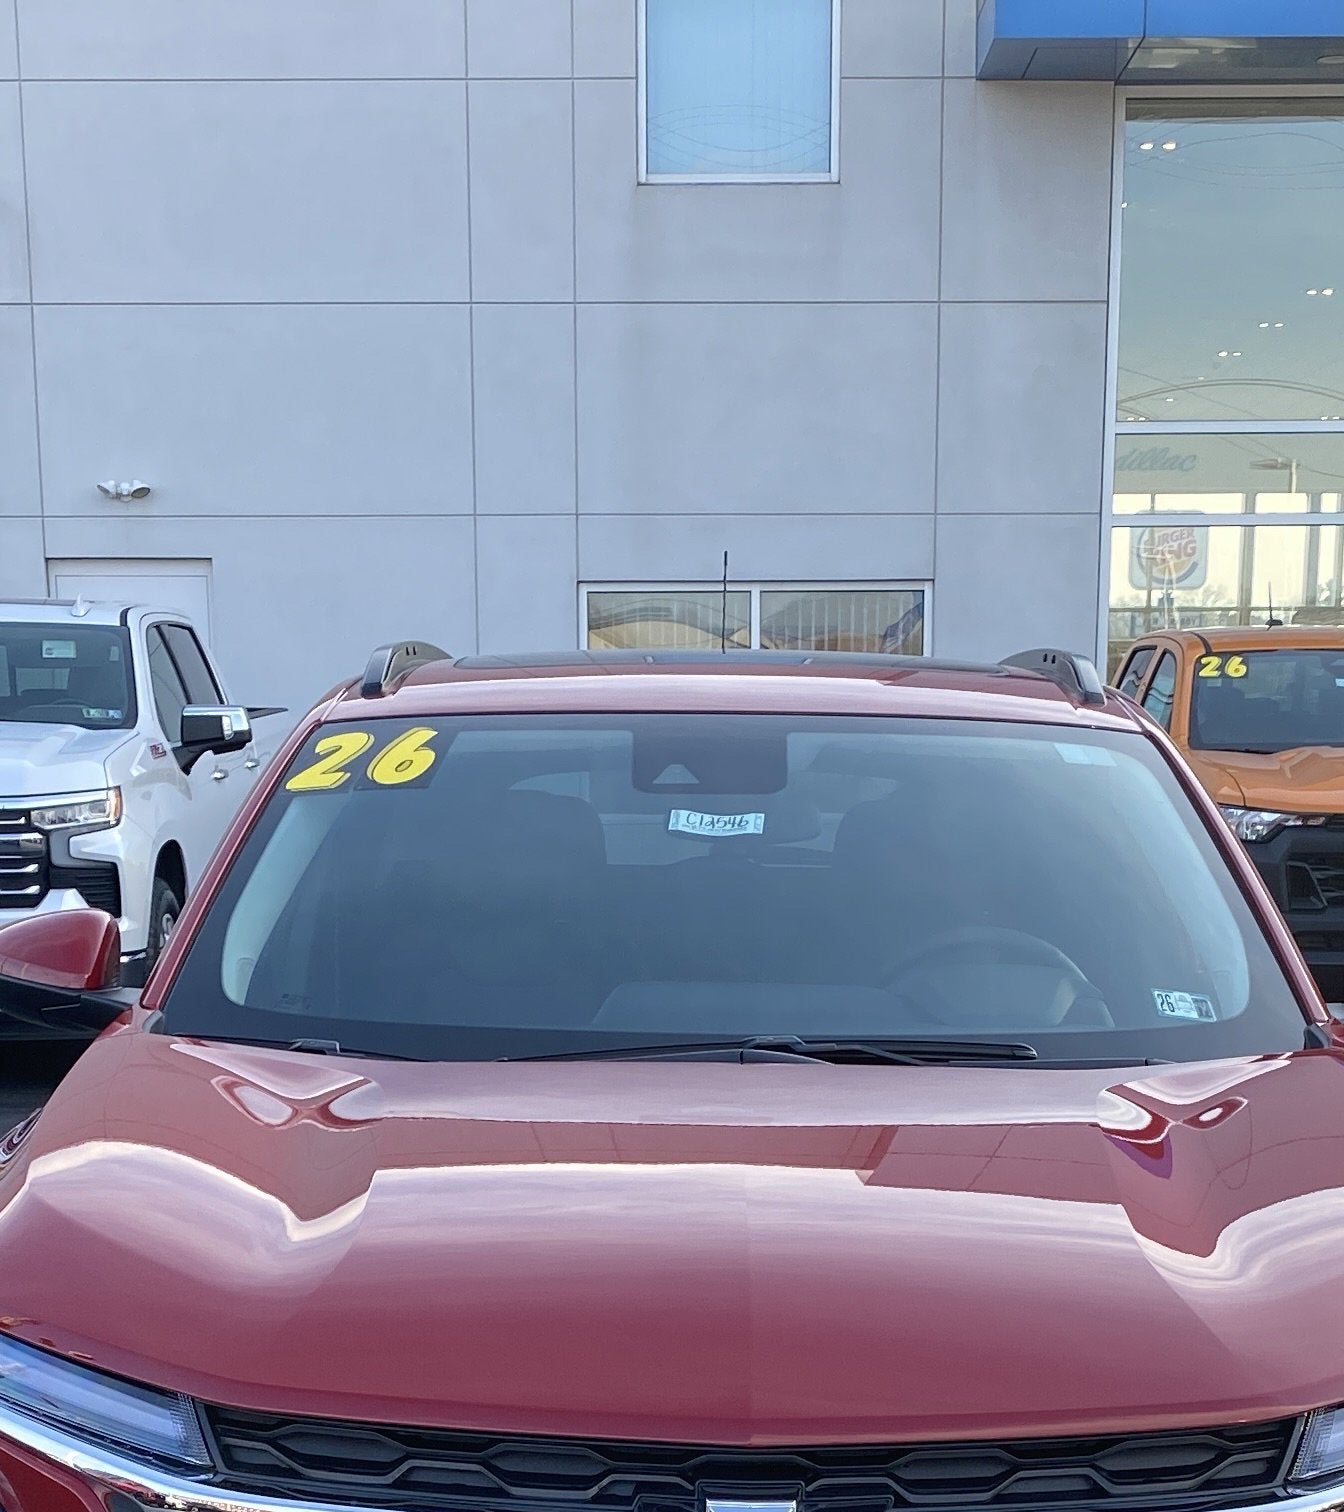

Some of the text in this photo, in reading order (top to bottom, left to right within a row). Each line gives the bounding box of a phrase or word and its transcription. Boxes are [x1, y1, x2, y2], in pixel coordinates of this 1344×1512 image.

[1116, 446, 1197, 472] dillac
[1198, 655, 1248, 678] 26
[285, 726, 439, 792] 26
[1156, 993, 1175, 1012] 26
